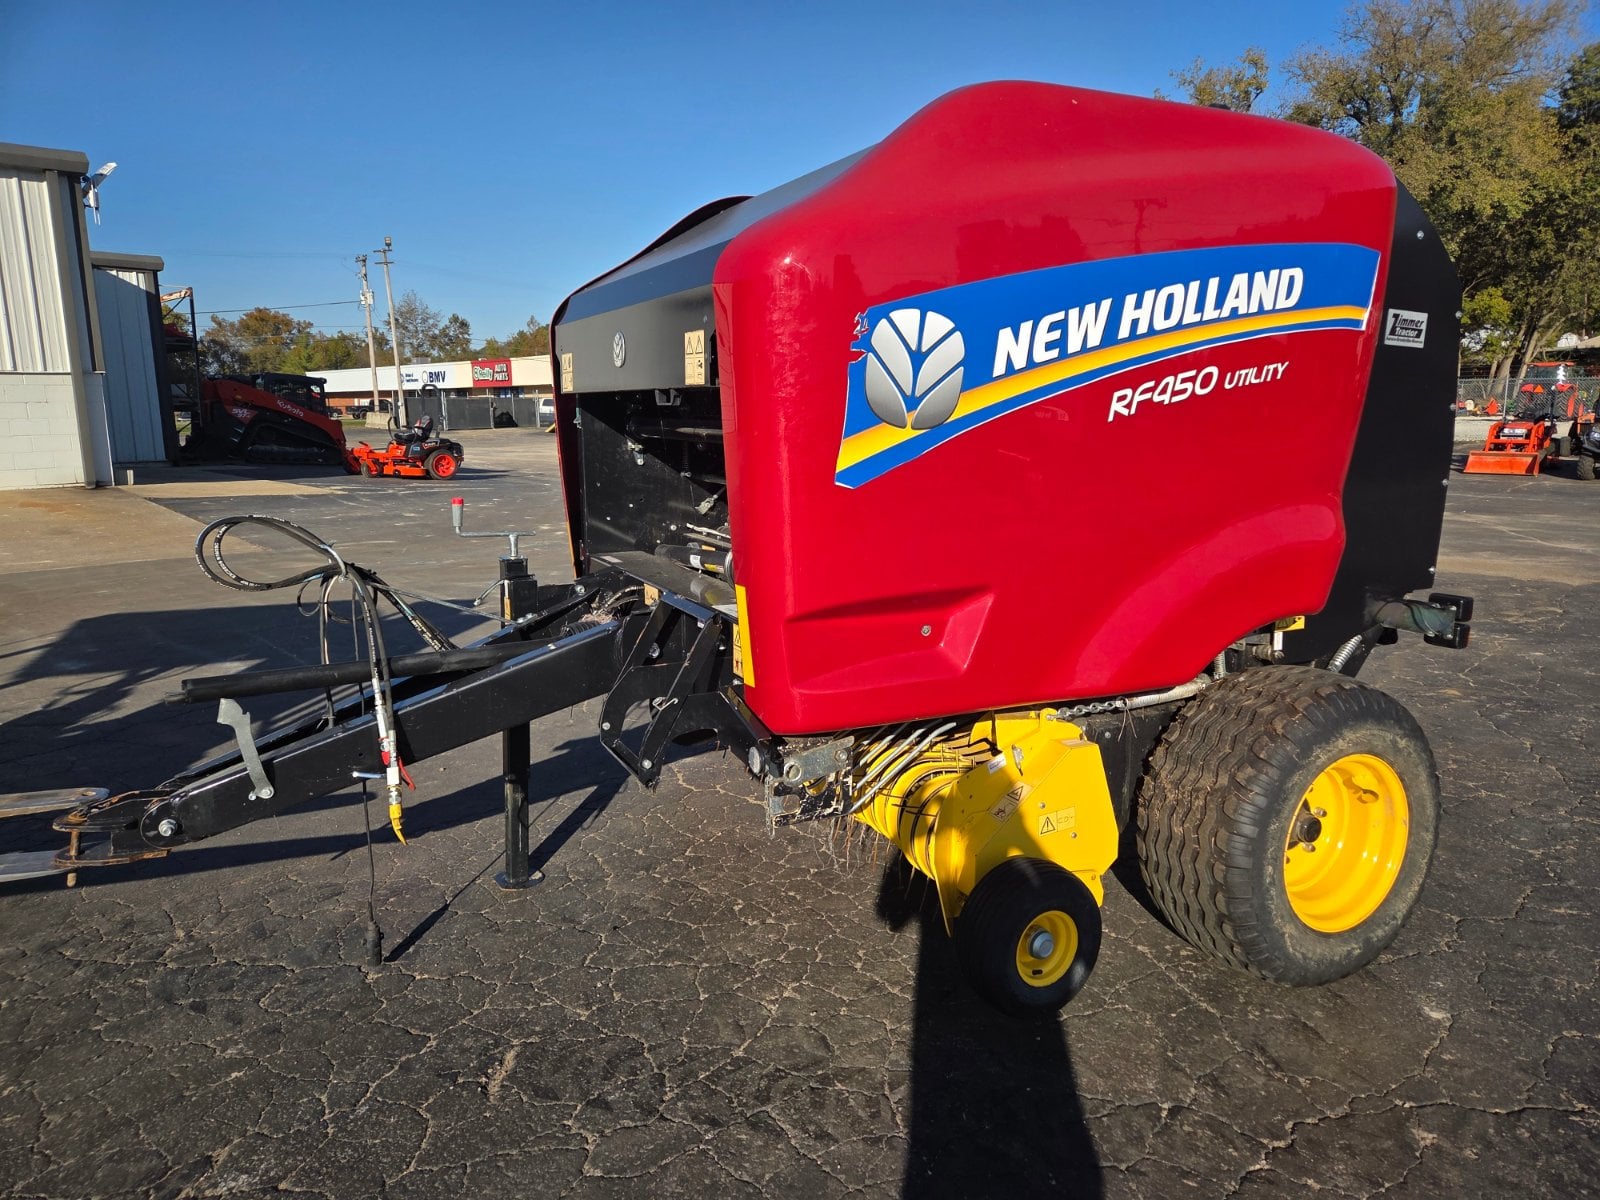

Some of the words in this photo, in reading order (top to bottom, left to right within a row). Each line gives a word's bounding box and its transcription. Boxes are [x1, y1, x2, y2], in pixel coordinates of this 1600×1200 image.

[993, 297, 1113, 378] NEW
[1117, 267, 1304, 340] HOLLAND
[1389, 313, 1424, 333] Zimmer
[1395, 327, 1418, 337] Tractor
[429, 371, 446, 383] BMV
[1107, 366, 1219, 422] RF450
[1224, 361, 1289, 390] UTILITY
